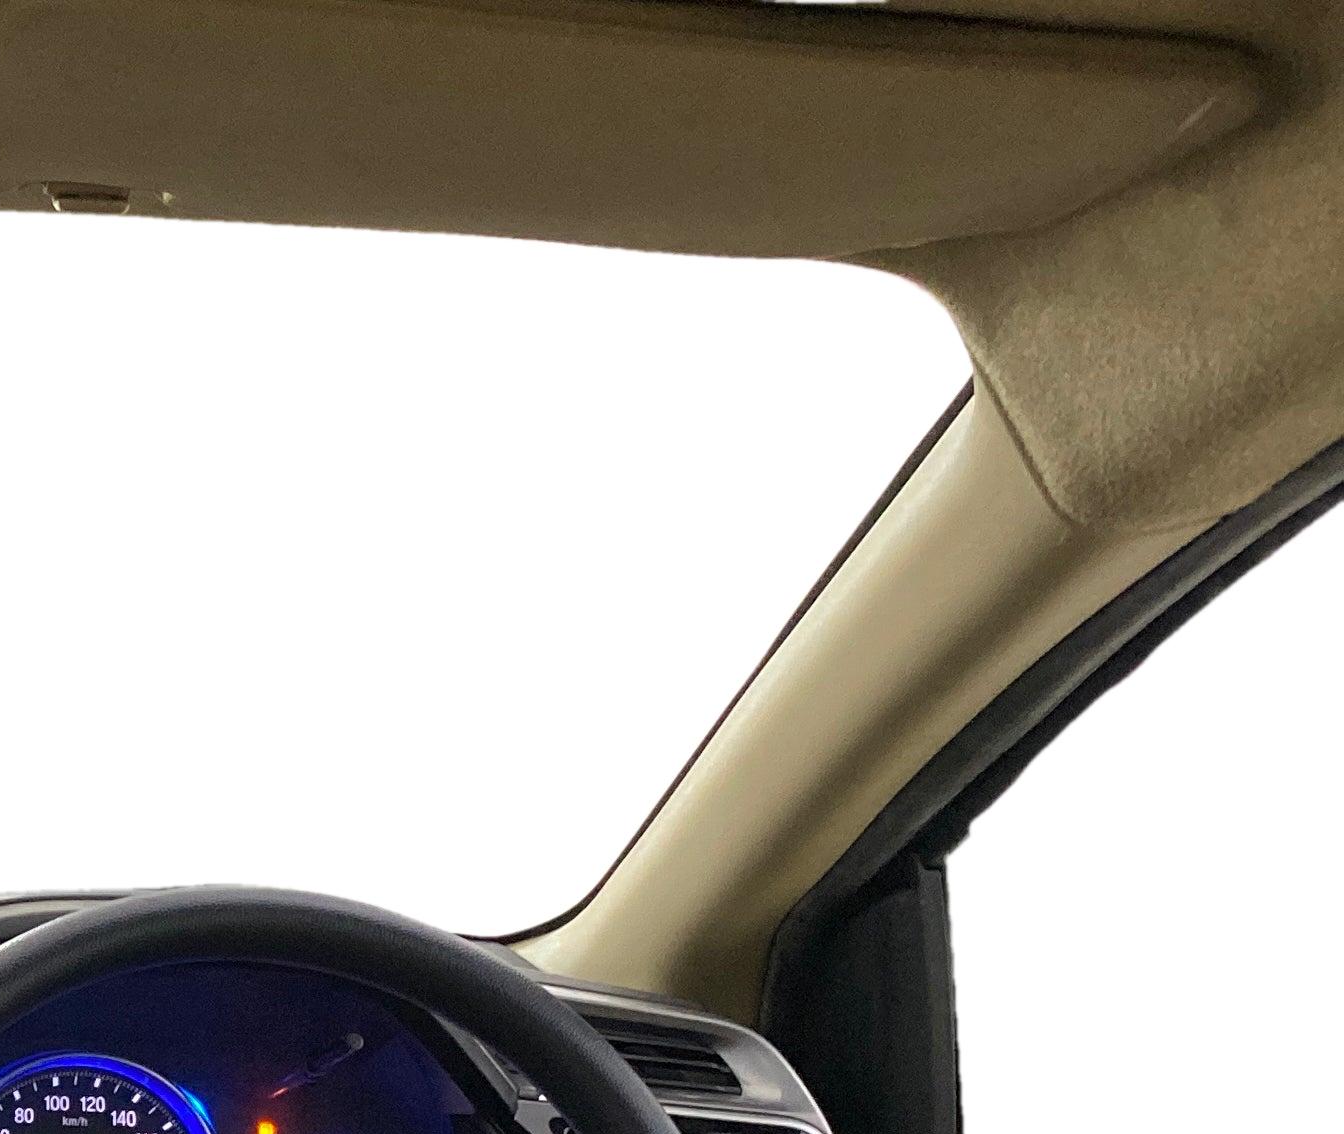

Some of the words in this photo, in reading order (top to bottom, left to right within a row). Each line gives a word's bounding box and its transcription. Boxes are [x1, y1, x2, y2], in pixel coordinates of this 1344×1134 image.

[44, 1095, 70, 1112] 100
[80, 1096, 106, 1113] 120
[14, 1107, 35, 1124] 80
[62, 1116, 88, 1127] km/h
[111, 1110, 137, 1128] 140
